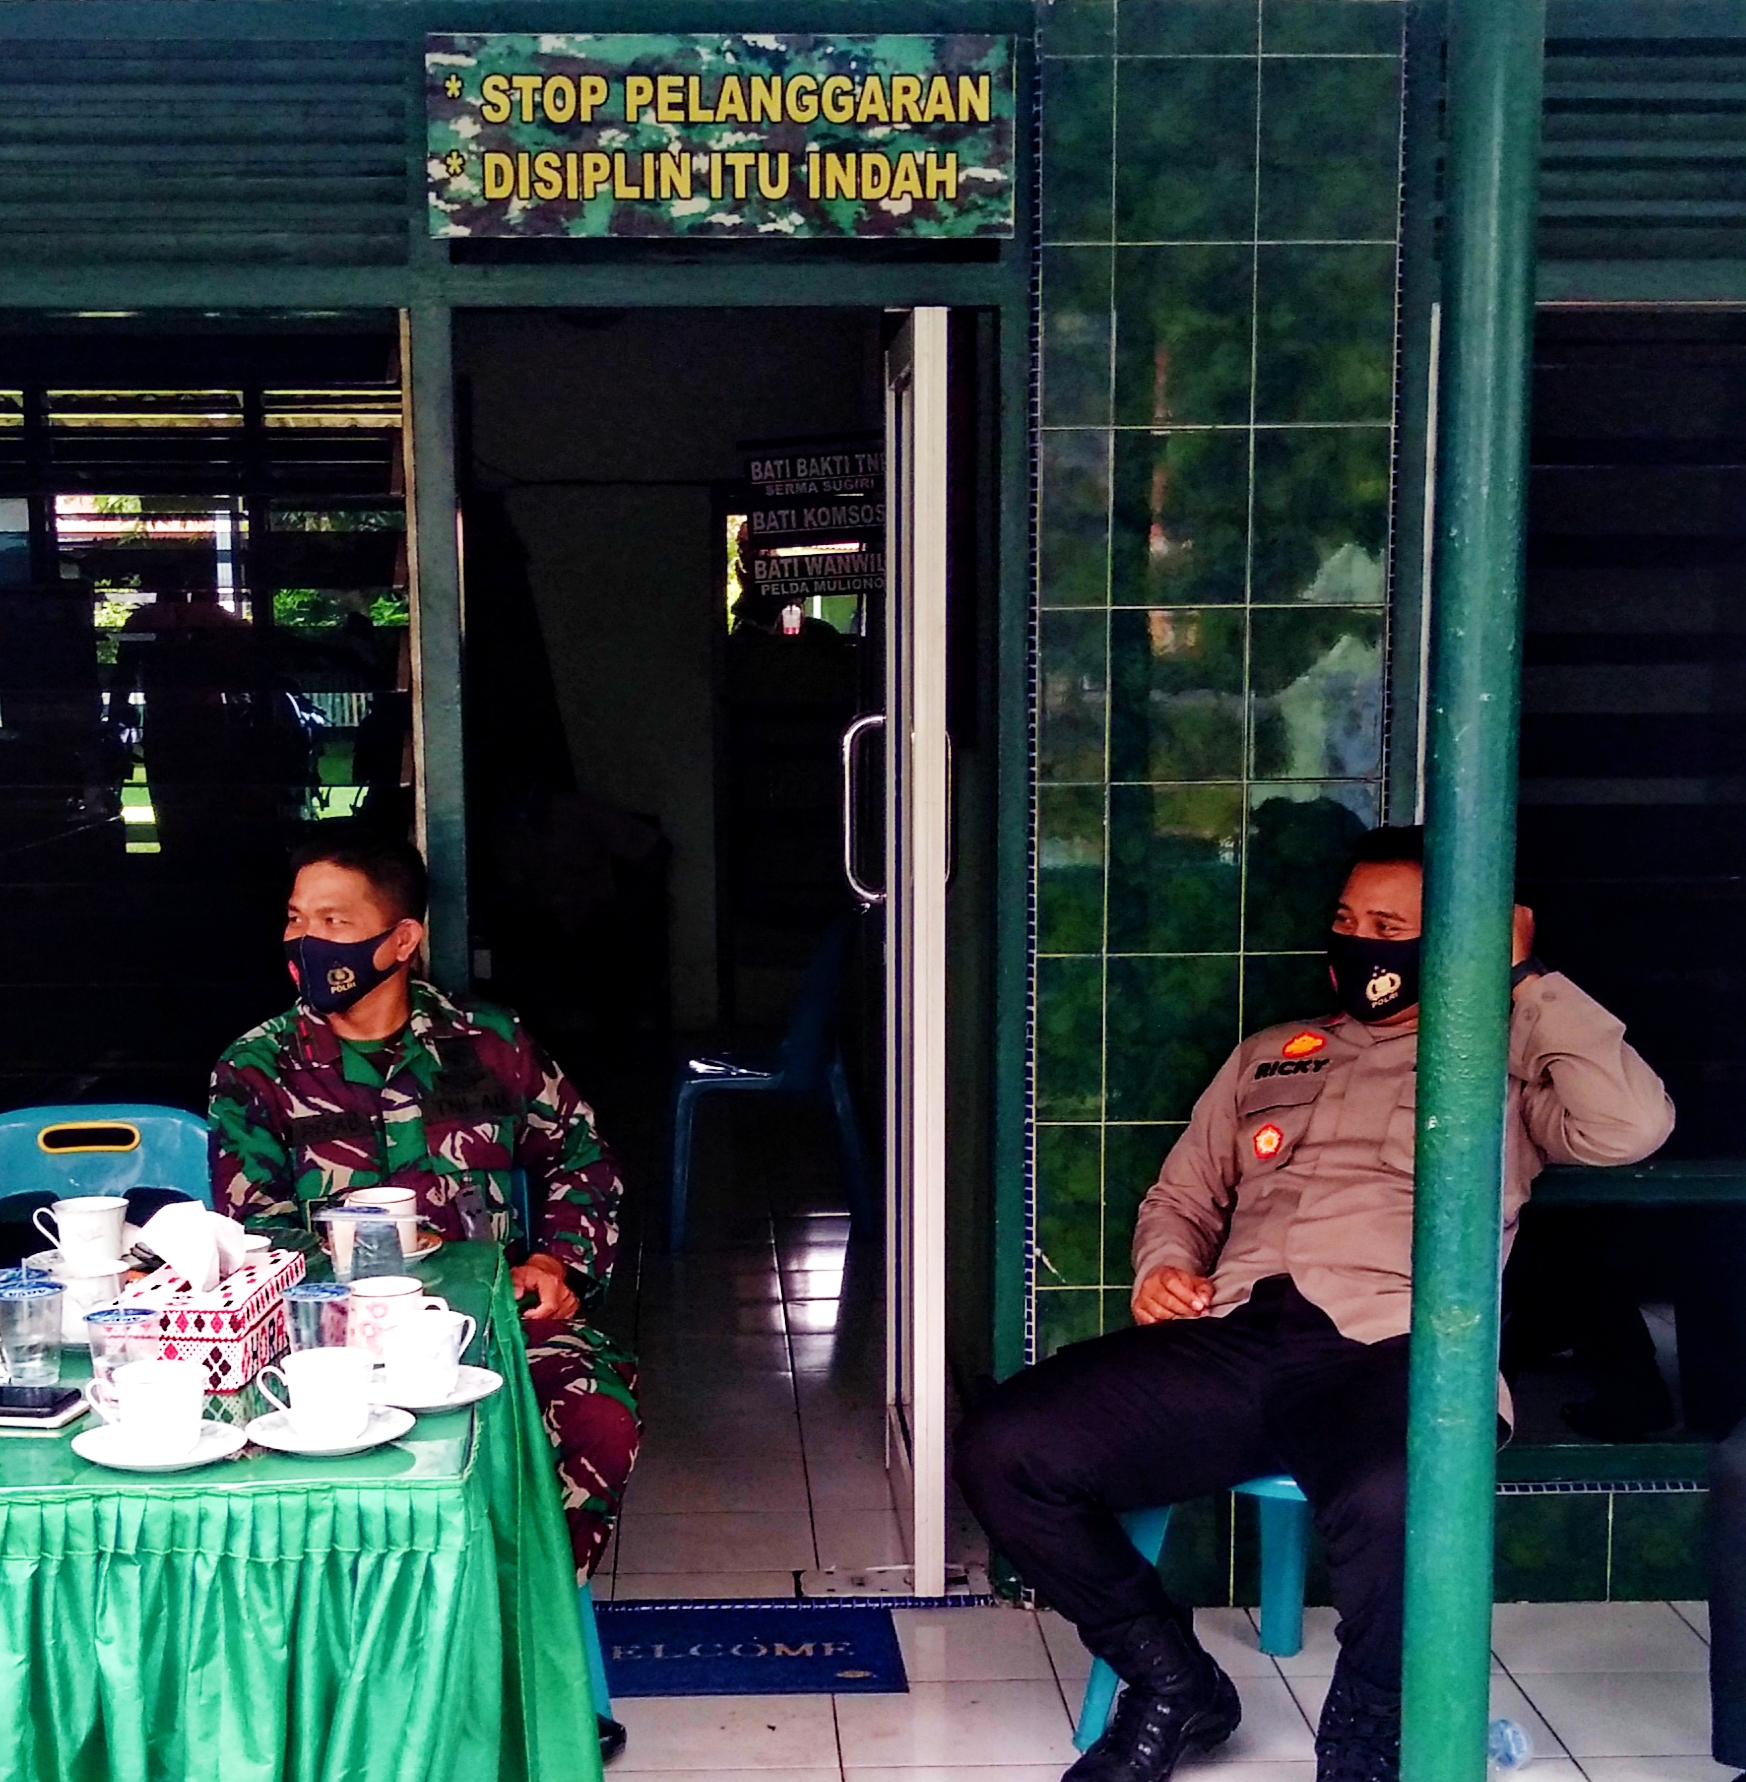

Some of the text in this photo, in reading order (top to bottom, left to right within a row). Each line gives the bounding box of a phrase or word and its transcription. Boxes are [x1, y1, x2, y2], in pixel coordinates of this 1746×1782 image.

[481, 73, 992, 124] STOP PELANGGARAN
[482, 151, 958, 201] DISIPLIN ITU INDAH
[751, 460, 790, 481] BATI
[796, 455, 850, 477] BAKTI
[765, 478, 875, 496] SERMA SUGIRI
[753, 504, 886, 530] BATI KOMSOS
[754, 553, 886, 579] BATI WANWIL
[761, 582, 810, 596] PELDA
[1255, 1059, 1329, 1079] RICKY
[611, 1641, 855, 1660] ELCOME
